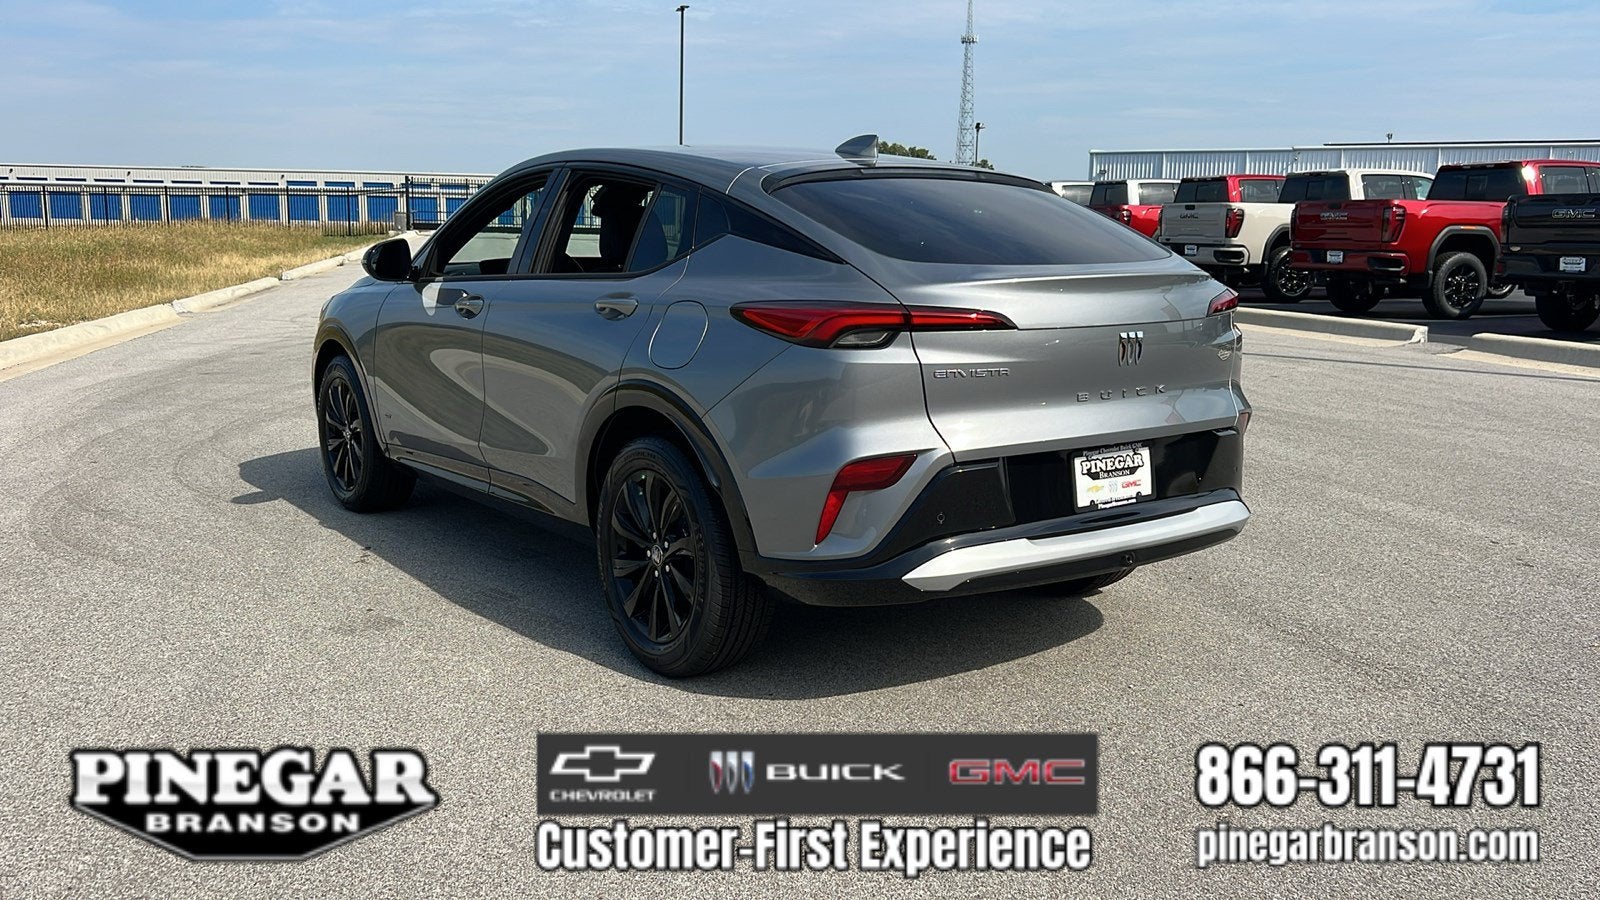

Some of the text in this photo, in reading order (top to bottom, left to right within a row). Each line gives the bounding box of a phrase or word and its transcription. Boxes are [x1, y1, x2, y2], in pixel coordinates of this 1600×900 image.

[1552, 208, 1596, 218] GMC
[933, 367, 1010, 379] ENVISTA
[1076, 383, 1167, 403] BUICK
[1081, 454, 1144, 474] PINEGAR
[1099, 469, 1131, 479] BRANSON
[1121, 480, 1142, 489] GMC
